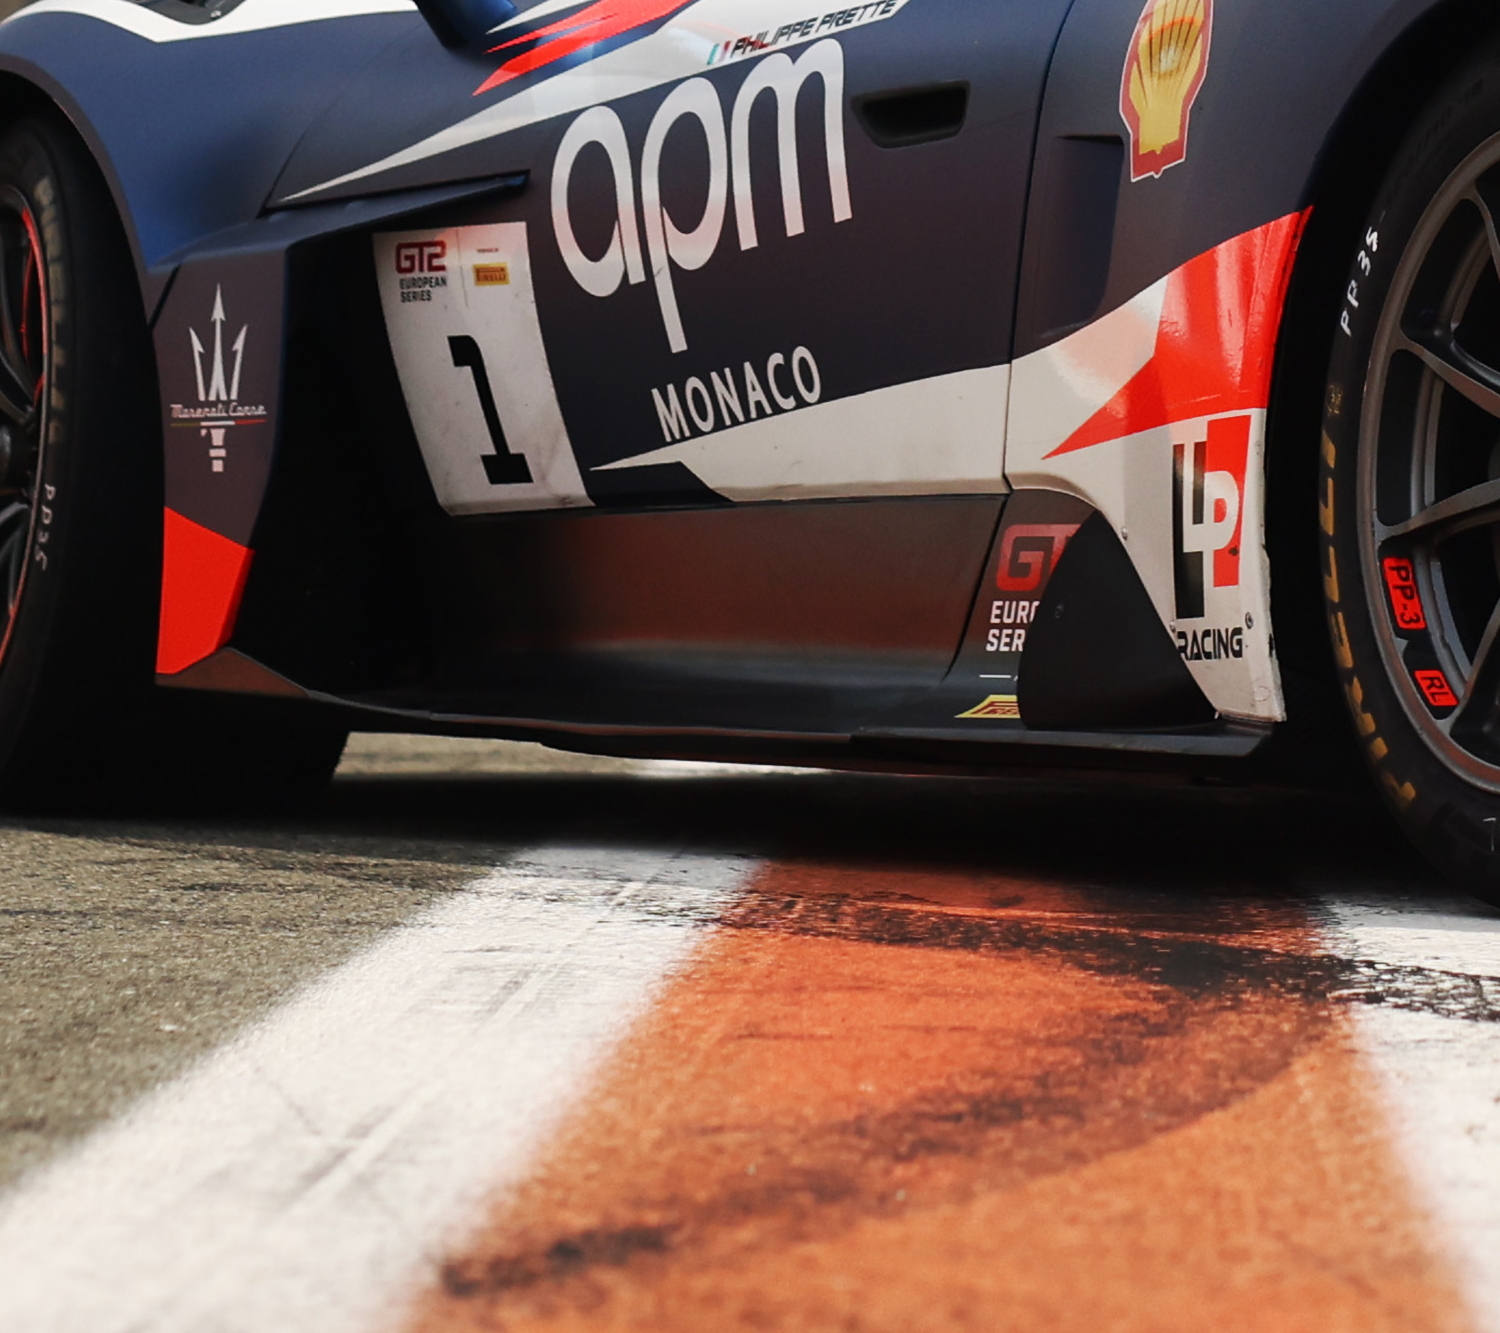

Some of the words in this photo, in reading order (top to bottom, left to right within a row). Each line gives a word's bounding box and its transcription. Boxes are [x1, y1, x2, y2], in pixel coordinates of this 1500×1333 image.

[730, 16, 819, 58] PHILIPPE
[551, 38, 852, 353] apm
[396, 240, 446, 274] GT2
[399, 276, 447, 292] EUROPEAN
[401, 290, 432, 303] SERIES
[448, 334, 534, 485] 1
[650, 345, 821, 443] MONACO
[996, 523, 1082, 592] GT
[1388, 564, 1421, 625] PP-3
[986, 629, 1026, 652] SER
[1319, 429, 1417, 813] PIRELLI
[1175, 626, 1244, 662] RACING
[1420, 676, 1450, 703] RL
